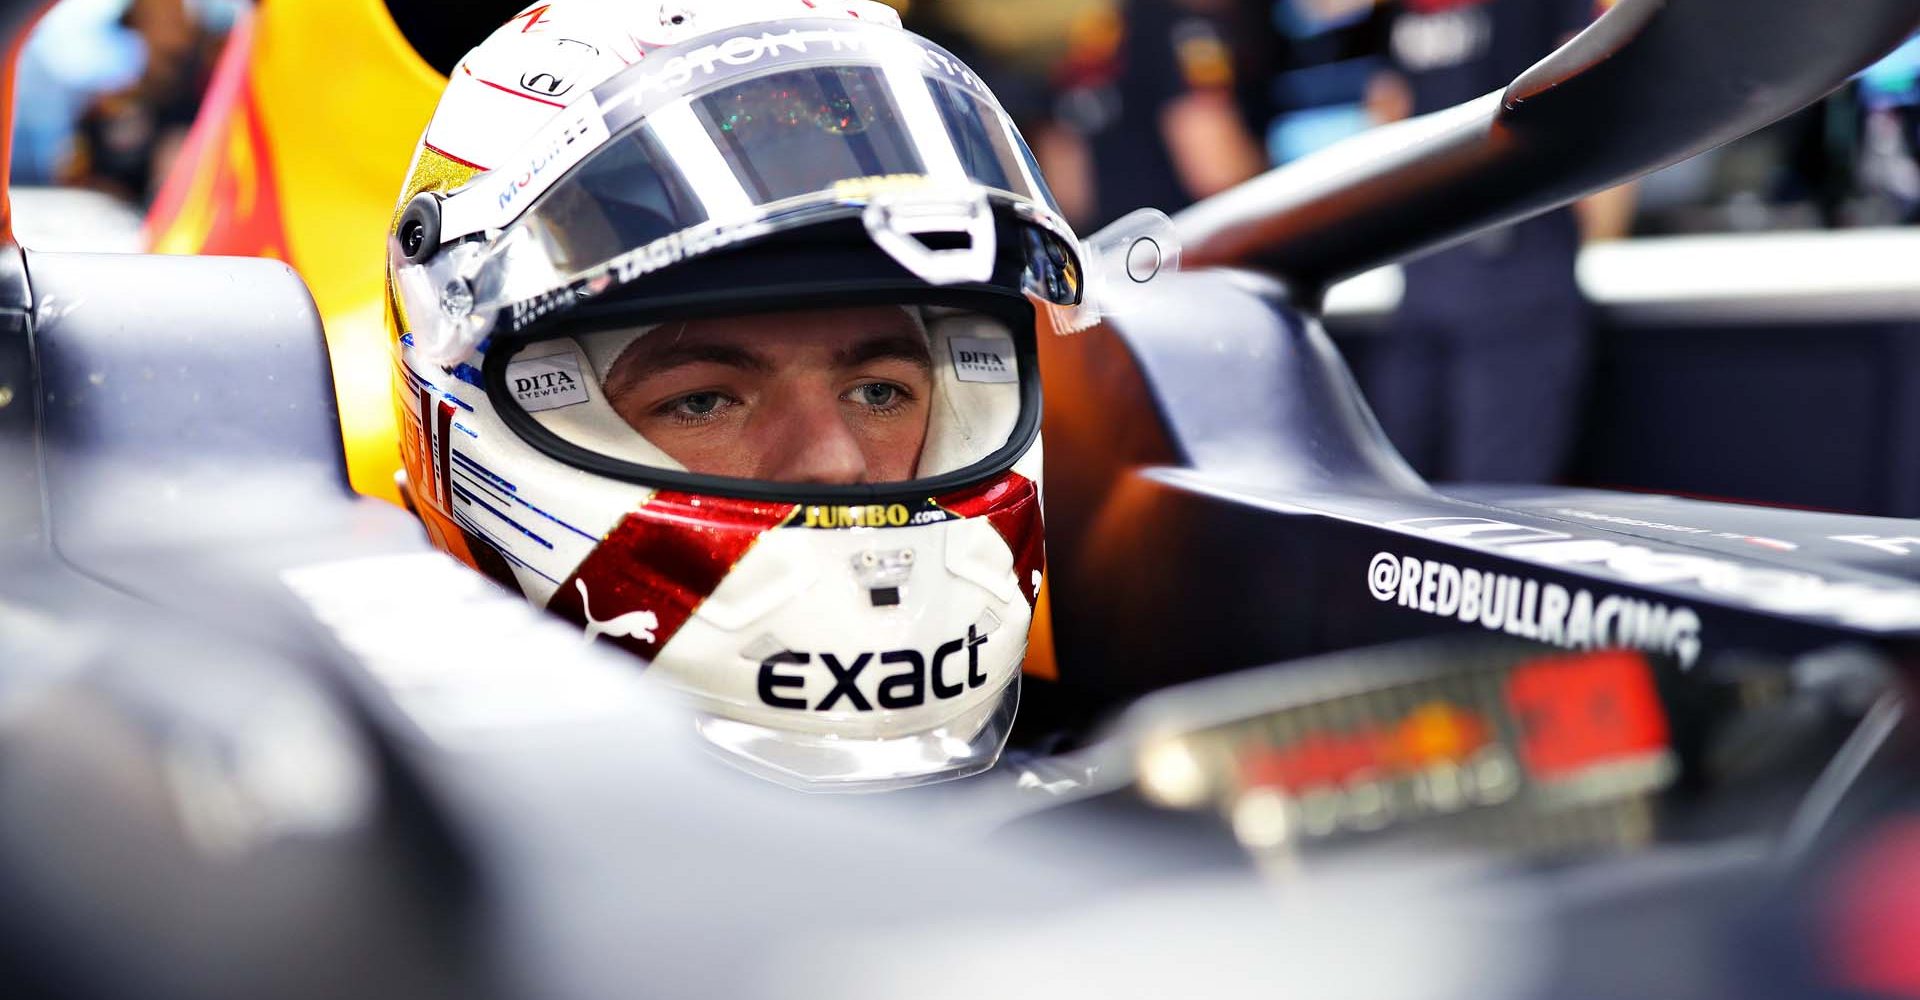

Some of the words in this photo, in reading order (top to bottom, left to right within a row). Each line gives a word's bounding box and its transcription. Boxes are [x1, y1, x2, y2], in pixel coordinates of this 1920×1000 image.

[624, 29, 807, 106] ASTON
[960, 351, 1003, 365] DITA
[515, 371, 574, 392] DITA
[518, 384, 576, 399] EYEWEAR
[1368, 551, 1701, 672] @REDBULLRACING
